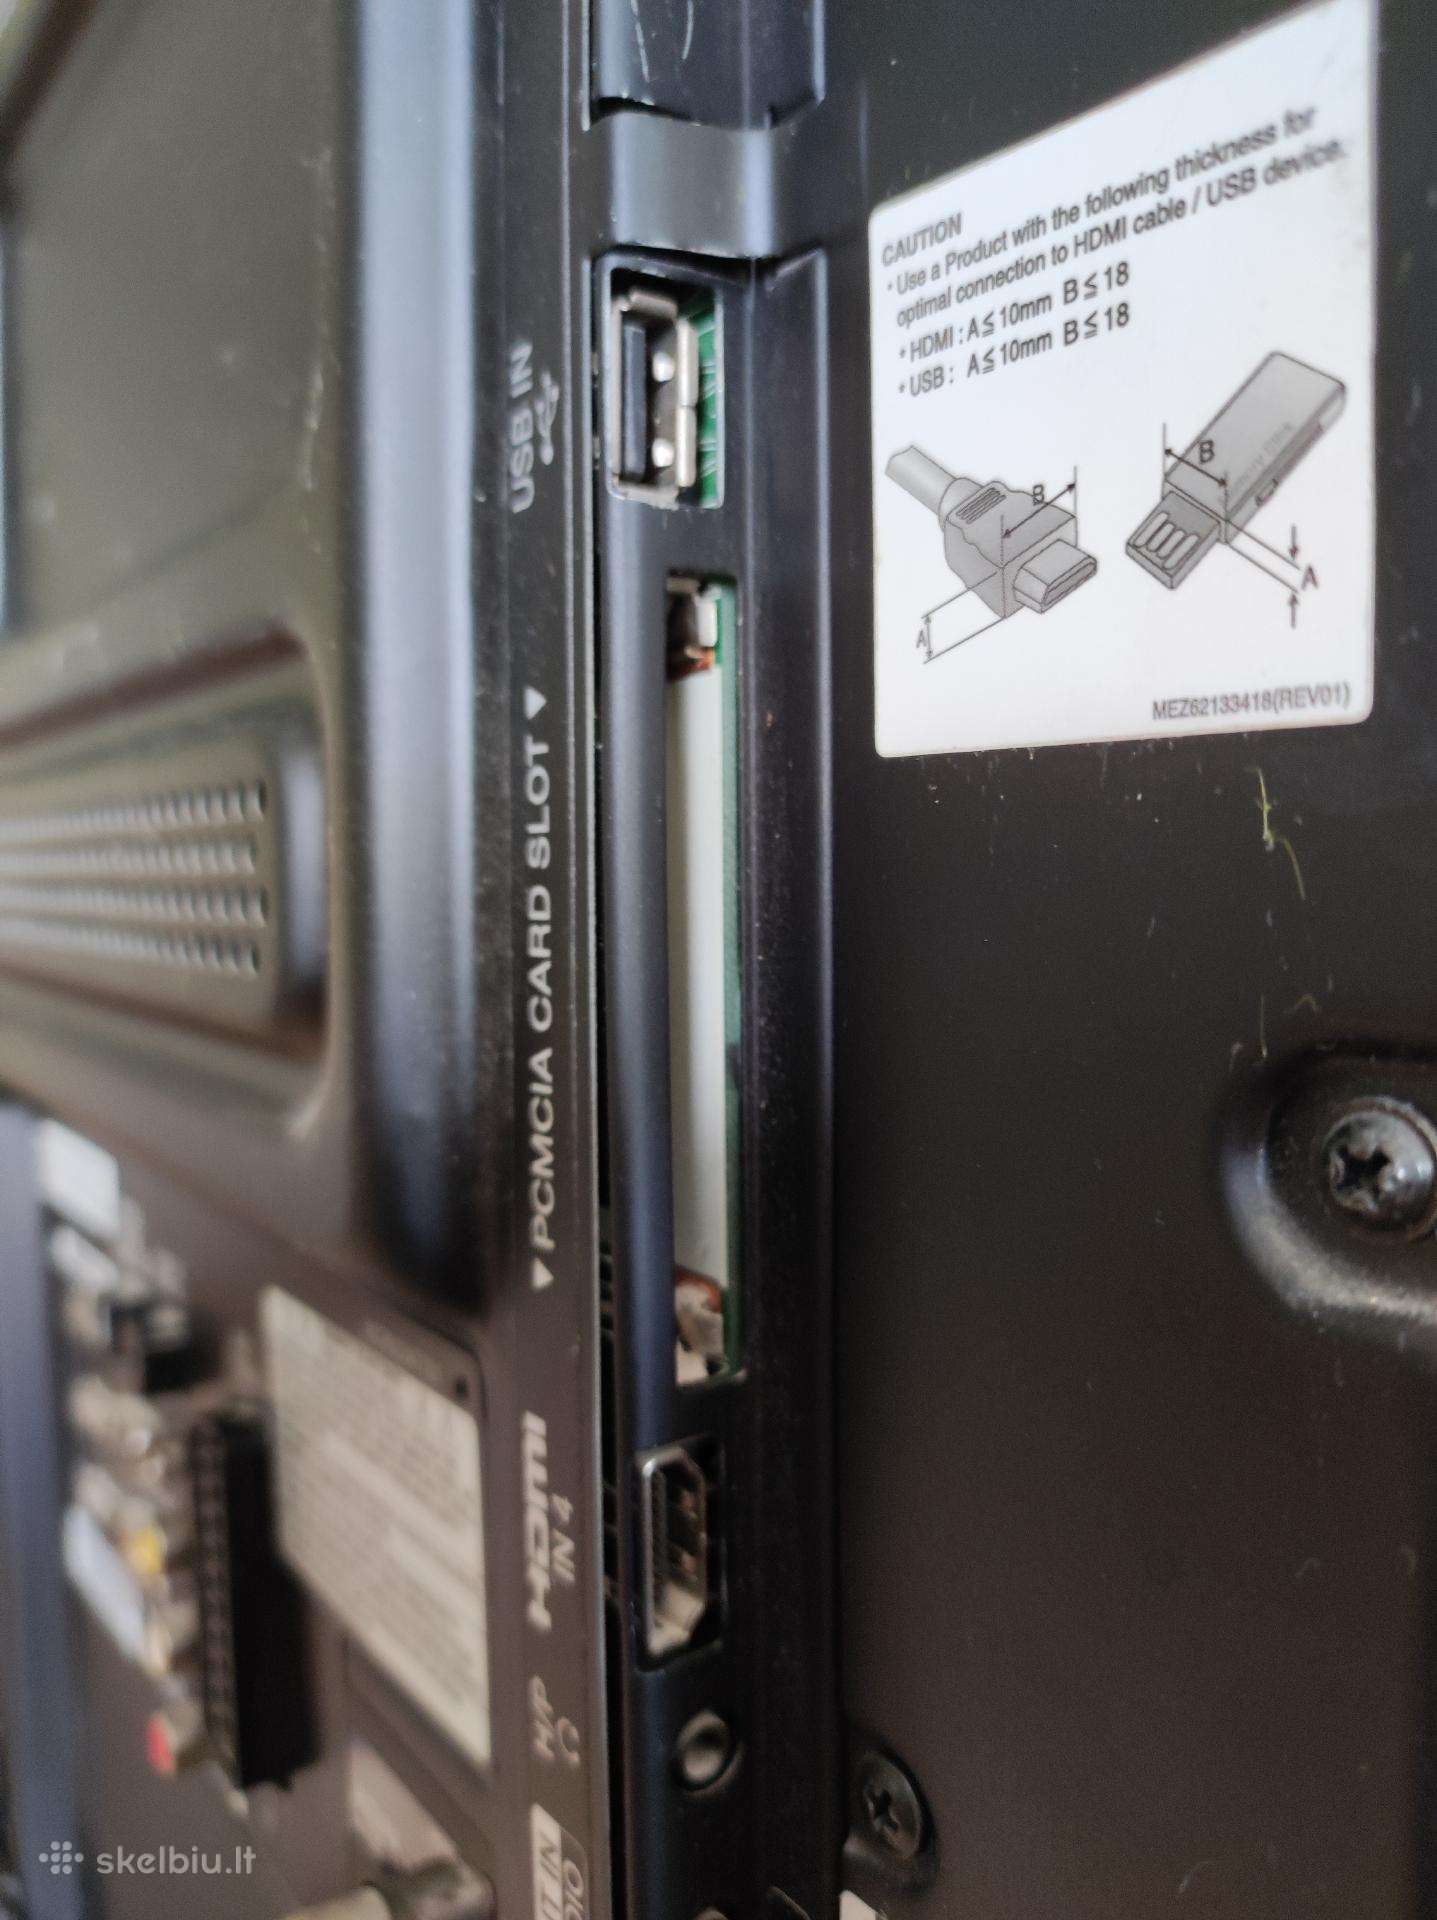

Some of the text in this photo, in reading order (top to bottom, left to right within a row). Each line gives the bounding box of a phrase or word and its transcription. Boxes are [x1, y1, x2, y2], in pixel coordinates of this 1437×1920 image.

[896, 106, 1315, 294] Use a Product with the following thickness for
[881, 212, 963, 267] CAUTION
[897, 286, 952, 329] optimal
[955, 253, 1045, 303] connection
[1051, 244, 1068, 266] to
[1074, 215, 1127, 257] HDMI
[1132, 197, 1187, 235] cable
[1206, 165, 1256, 207] USB
[910, 326, 953, 362] HDMI
[508, 339, 535, 514] USB IN
[1200, 440, 1215, 464] B
[1033, 485, 1045, 504] B
[1302, 565, 1319, 590] A
[916, 629, 927, 648] A
[525, 734, 555, 1251] PCMCIA CARD SLOT
[521, 1411, 551, 1632] HDMI
[550, 1494, 576, 1583] IN 4
